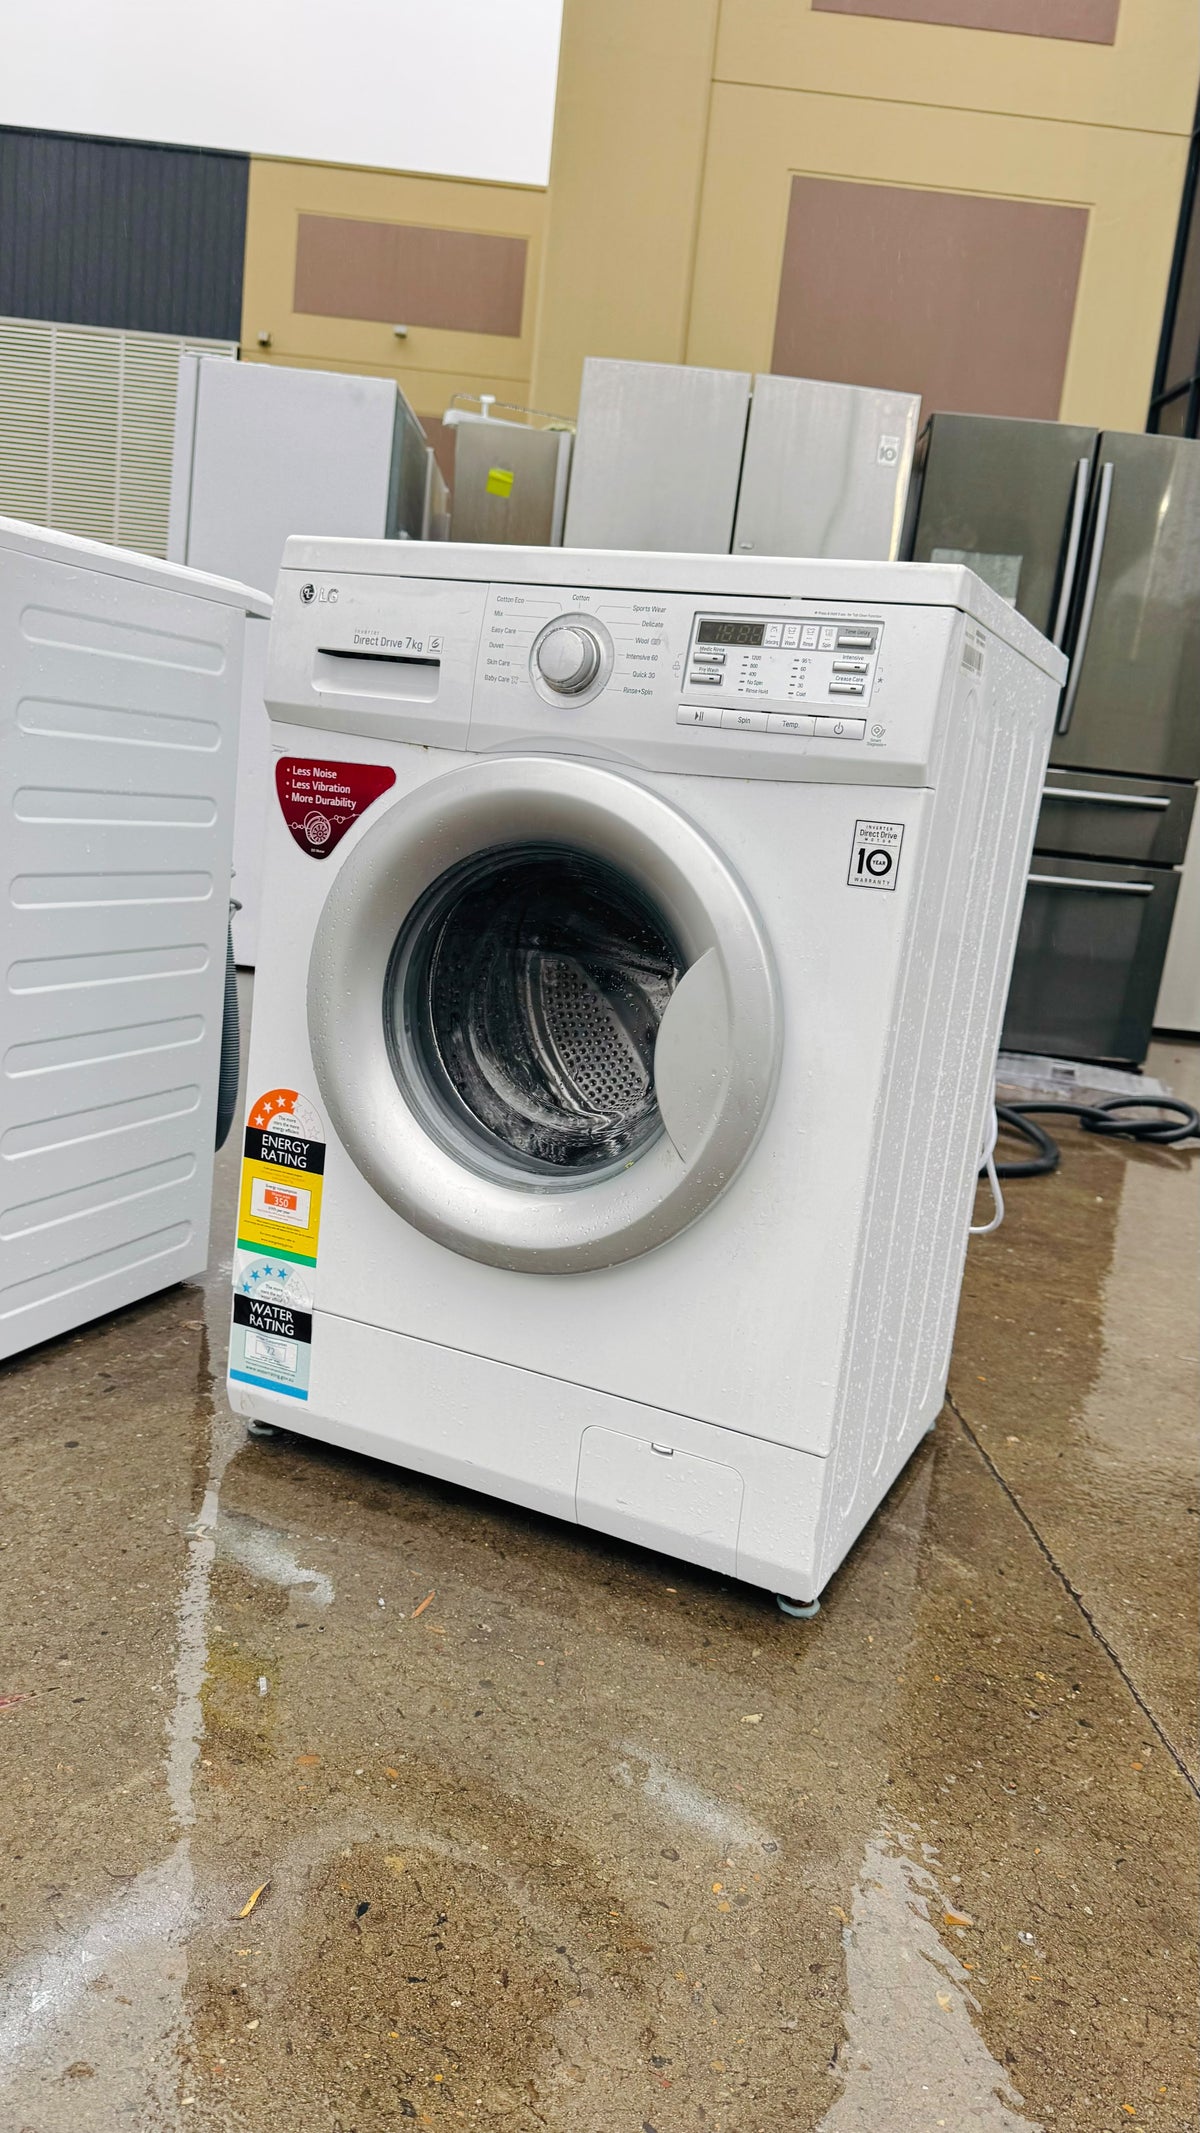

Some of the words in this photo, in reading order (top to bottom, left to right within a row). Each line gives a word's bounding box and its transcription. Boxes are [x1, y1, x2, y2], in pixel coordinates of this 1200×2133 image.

[319, 587, 339, 603] LG
[492, 626, 503, 634] Easy
[642, 620, 664, 628] Delicate
[354, 635, 378, 646] Direct
[381, 637, 402, 648] Drive
[405, 637, 423, 652] 7kg
[626, 653, 650, 661] Intensive
[623, 686, 653, 695] Rinse+Spin
[737, 716, 751, 724] Spin
[293, 766, 311, 776] Less
[313, 767, 337, 779] Noise
[292, 779, 310, 790] Less
[312, 781, 351, 794] Vibration
[292, 792, 313, 804] More
[315, 795, 356, 810] Durability
[860, 829, 879, 838] Direct
[880, 831, 898, 839] Drive
[857, 848, 892, 876] 10
[854, 877, 890, 885] WARRANTY
[262, 1134, 309, 1155] ENERGY
[261, 1147, 307, 1168] RATING
[274, 1196, 289, 1208] 350
[250, 1301, 294, 1323] WATER
[249, 1314, 295, 1336] RATING
